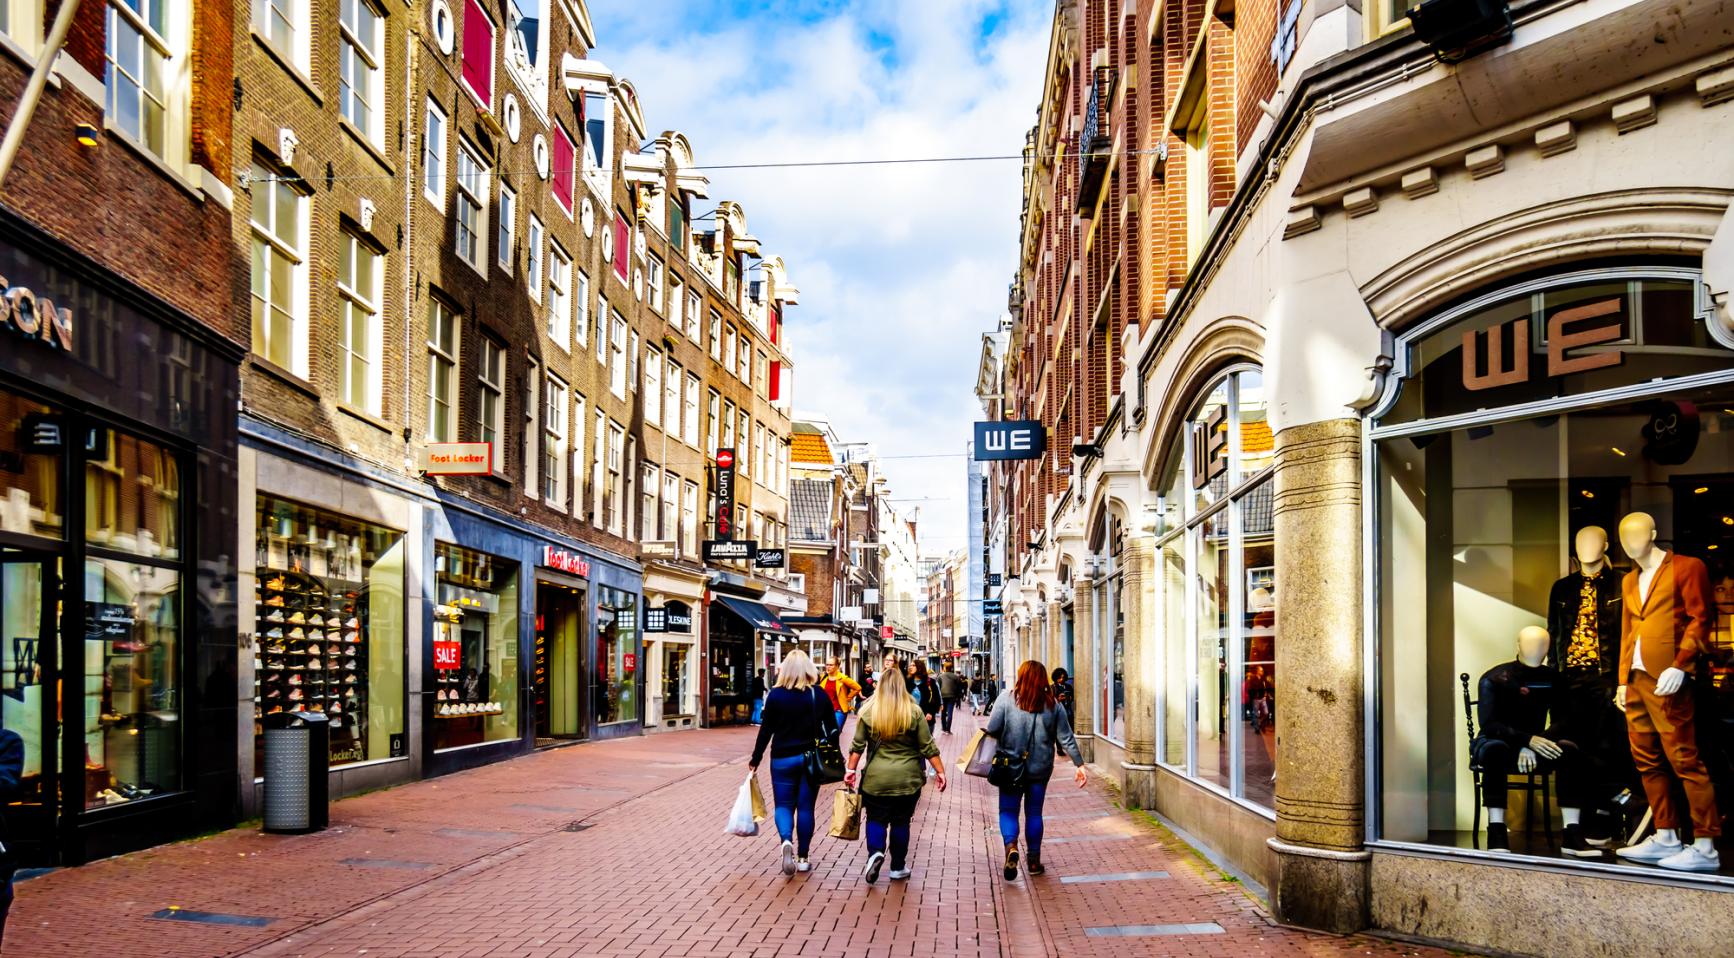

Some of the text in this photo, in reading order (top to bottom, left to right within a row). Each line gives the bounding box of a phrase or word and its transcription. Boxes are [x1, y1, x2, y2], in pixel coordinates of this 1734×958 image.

[1462, 297, 1622, 391] WE
[985, 429, 1031, 451] WE
[1192, 404, 1228, 490] WE
[431, 453, 485, 462] Foot Locker
[720, 470, 730, 504] Luna's
[710, 541, 748, 553] LAVAZZA
[756, 551, 782, 561] Kiehl's
[436, 648, 457, 663] SALE
